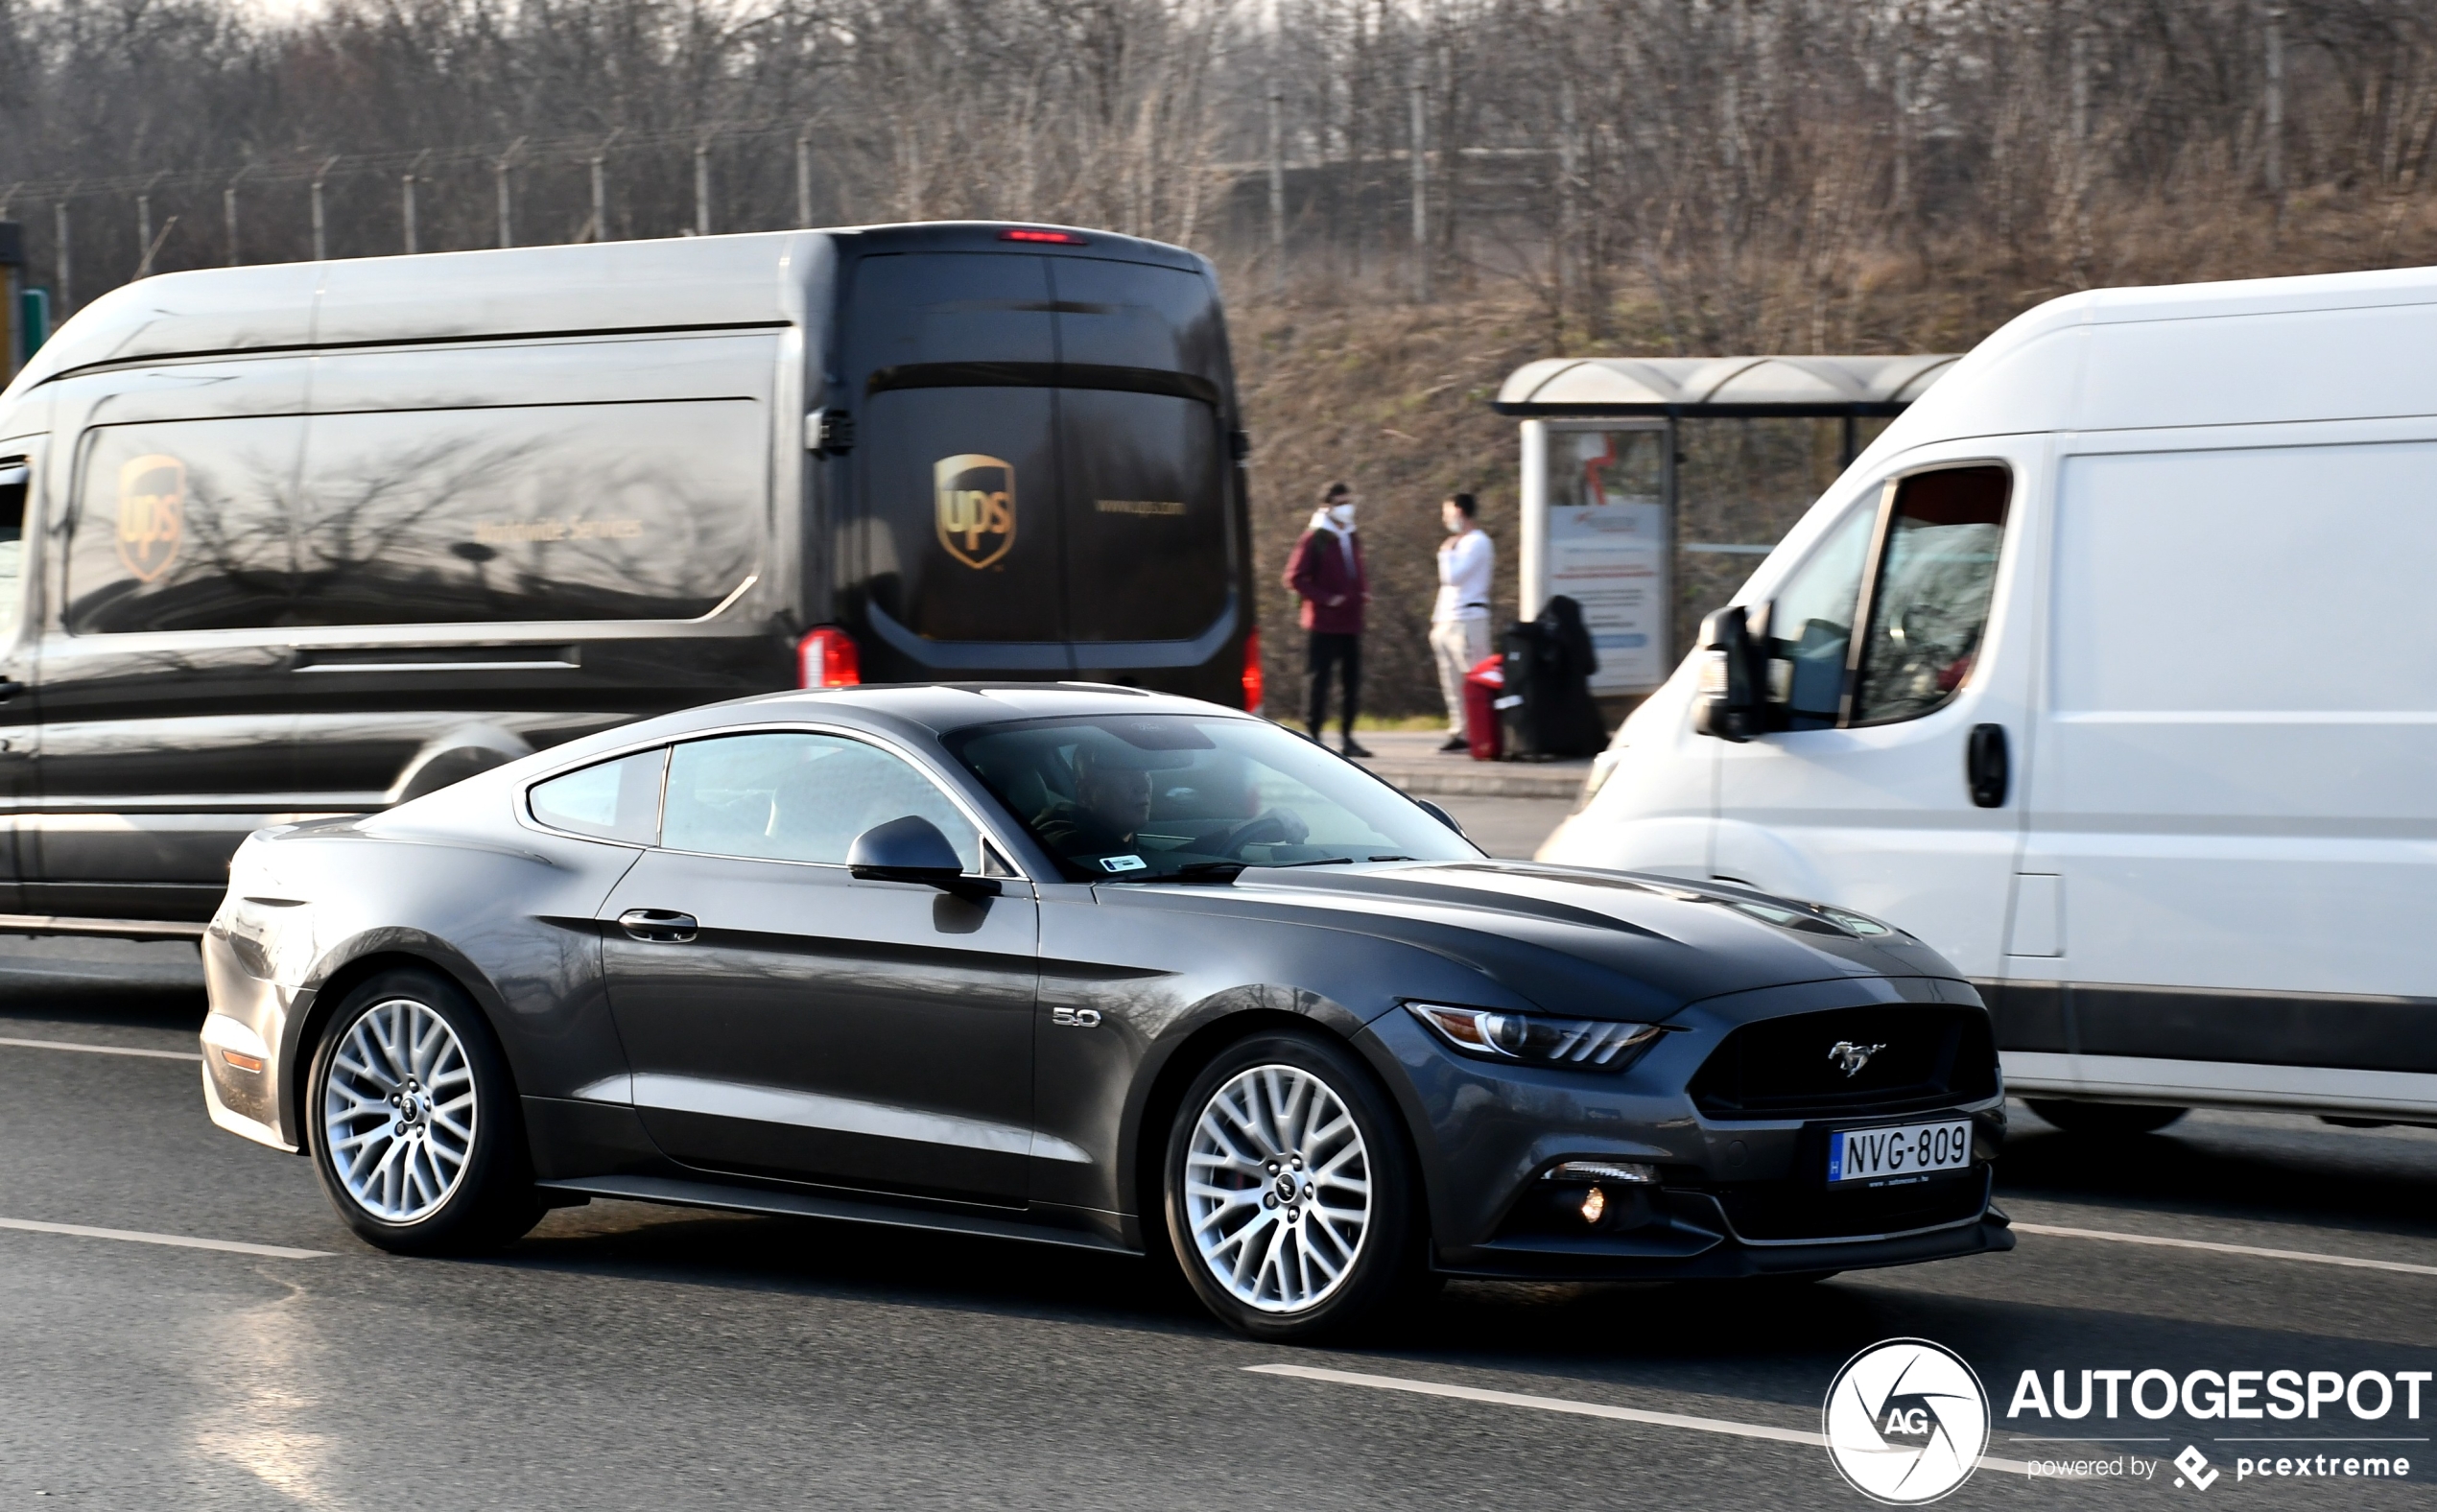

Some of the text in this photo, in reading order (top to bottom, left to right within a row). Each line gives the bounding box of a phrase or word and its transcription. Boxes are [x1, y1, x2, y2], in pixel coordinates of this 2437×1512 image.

[120, 494, 180, 560] ups
[940, 490, 1012, 550] ups
[1053, 1006, 1101, 1028] 5.0
[1847, 1125, 1966, 1175] NVG-809
